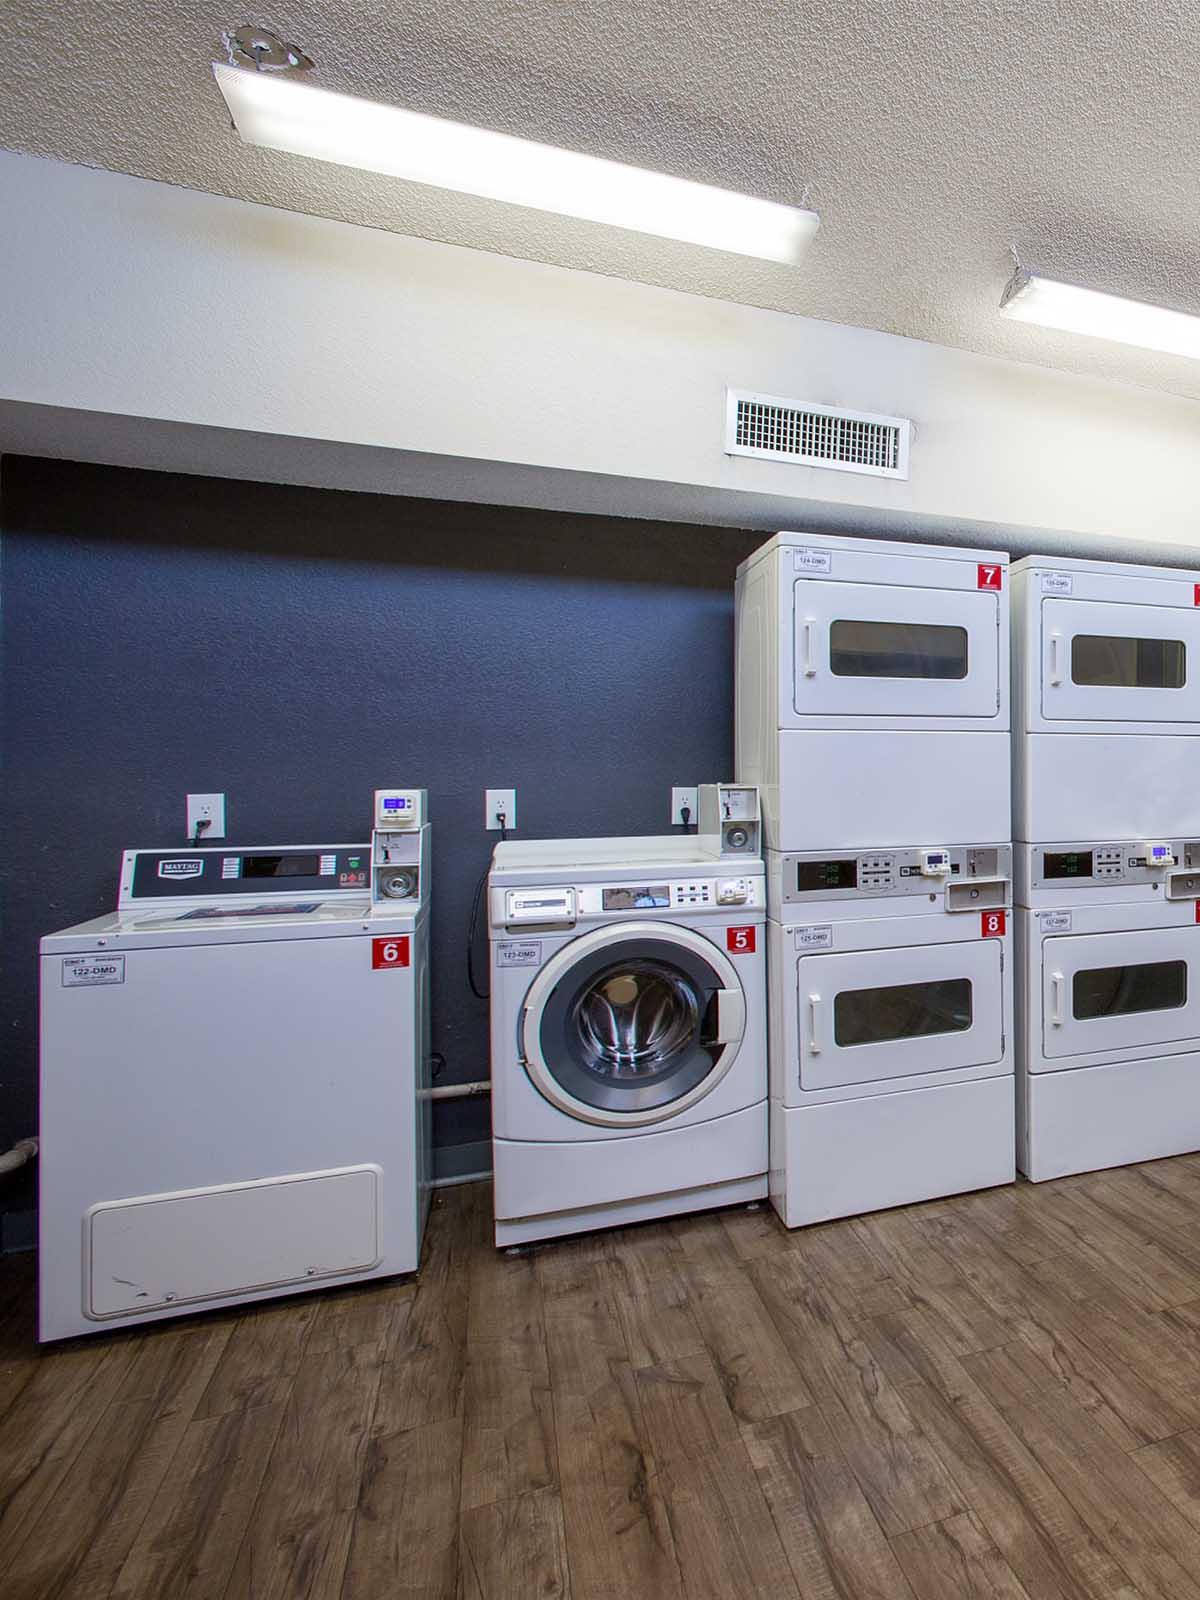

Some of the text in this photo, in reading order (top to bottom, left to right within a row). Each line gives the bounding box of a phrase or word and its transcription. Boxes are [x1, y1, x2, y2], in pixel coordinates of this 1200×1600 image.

[984, 569, 995, 584] 7
[988, 916, 998, 931] 8
[735, 932, 747, 948] 5
[384, 944, 399, 961] 6
[73, 966, 116, 976] 122-DMD
